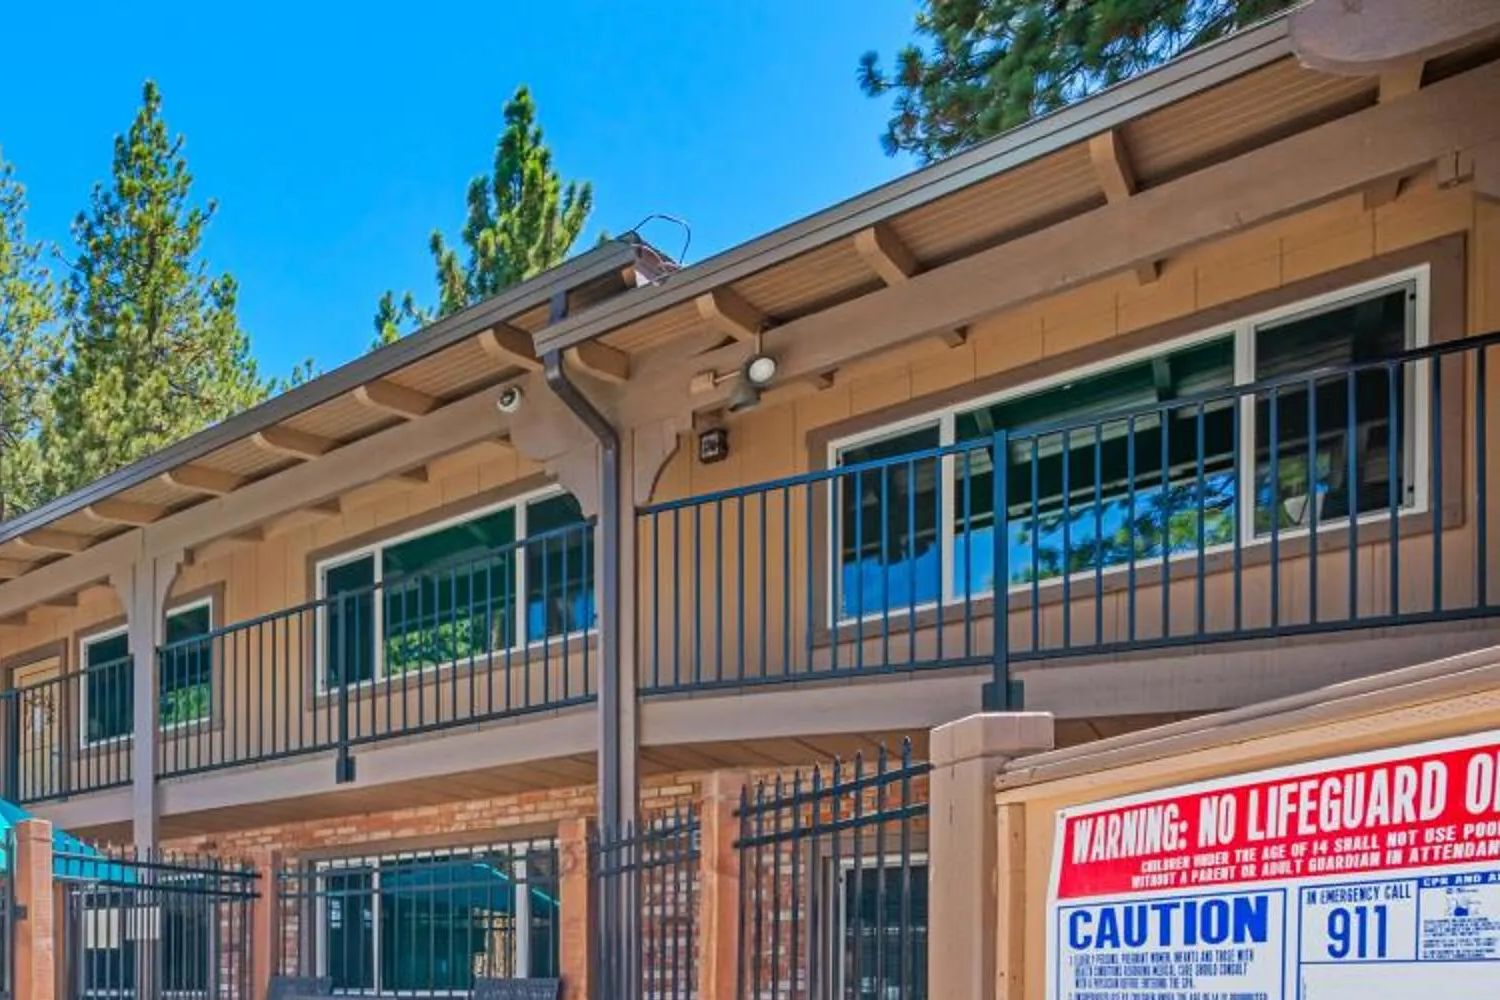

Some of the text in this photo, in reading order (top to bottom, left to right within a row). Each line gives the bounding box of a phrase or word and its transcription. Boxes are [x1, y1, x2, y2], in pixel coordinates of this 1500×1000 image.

[1072, 803, 1188, 864] WARNING:
[1198, 794, 1236, 848] NO
[1247, 760, 1447, 840] LIFEGUARD
[1141, 820, 1500, 873] CHILDREN UNDER THE AGE OF 14 SHALL NOT USE POO
[1180, 871, 1187, 884] A
[1191, 865, 1236, 882] PARENT
[1241, 862, 1257, 877] OR
[1262, 858, 1302, 877] ADULT
[1308, 851, 1380, 873] GUARDIAN
[1386, 848, 1402, 865] IN
[1306, 883, 1412, 905] IN EMERGENCY CALL
[1068, 895, 1269, 950] CAUTION
[1327, 905, 1387, 959] 911
